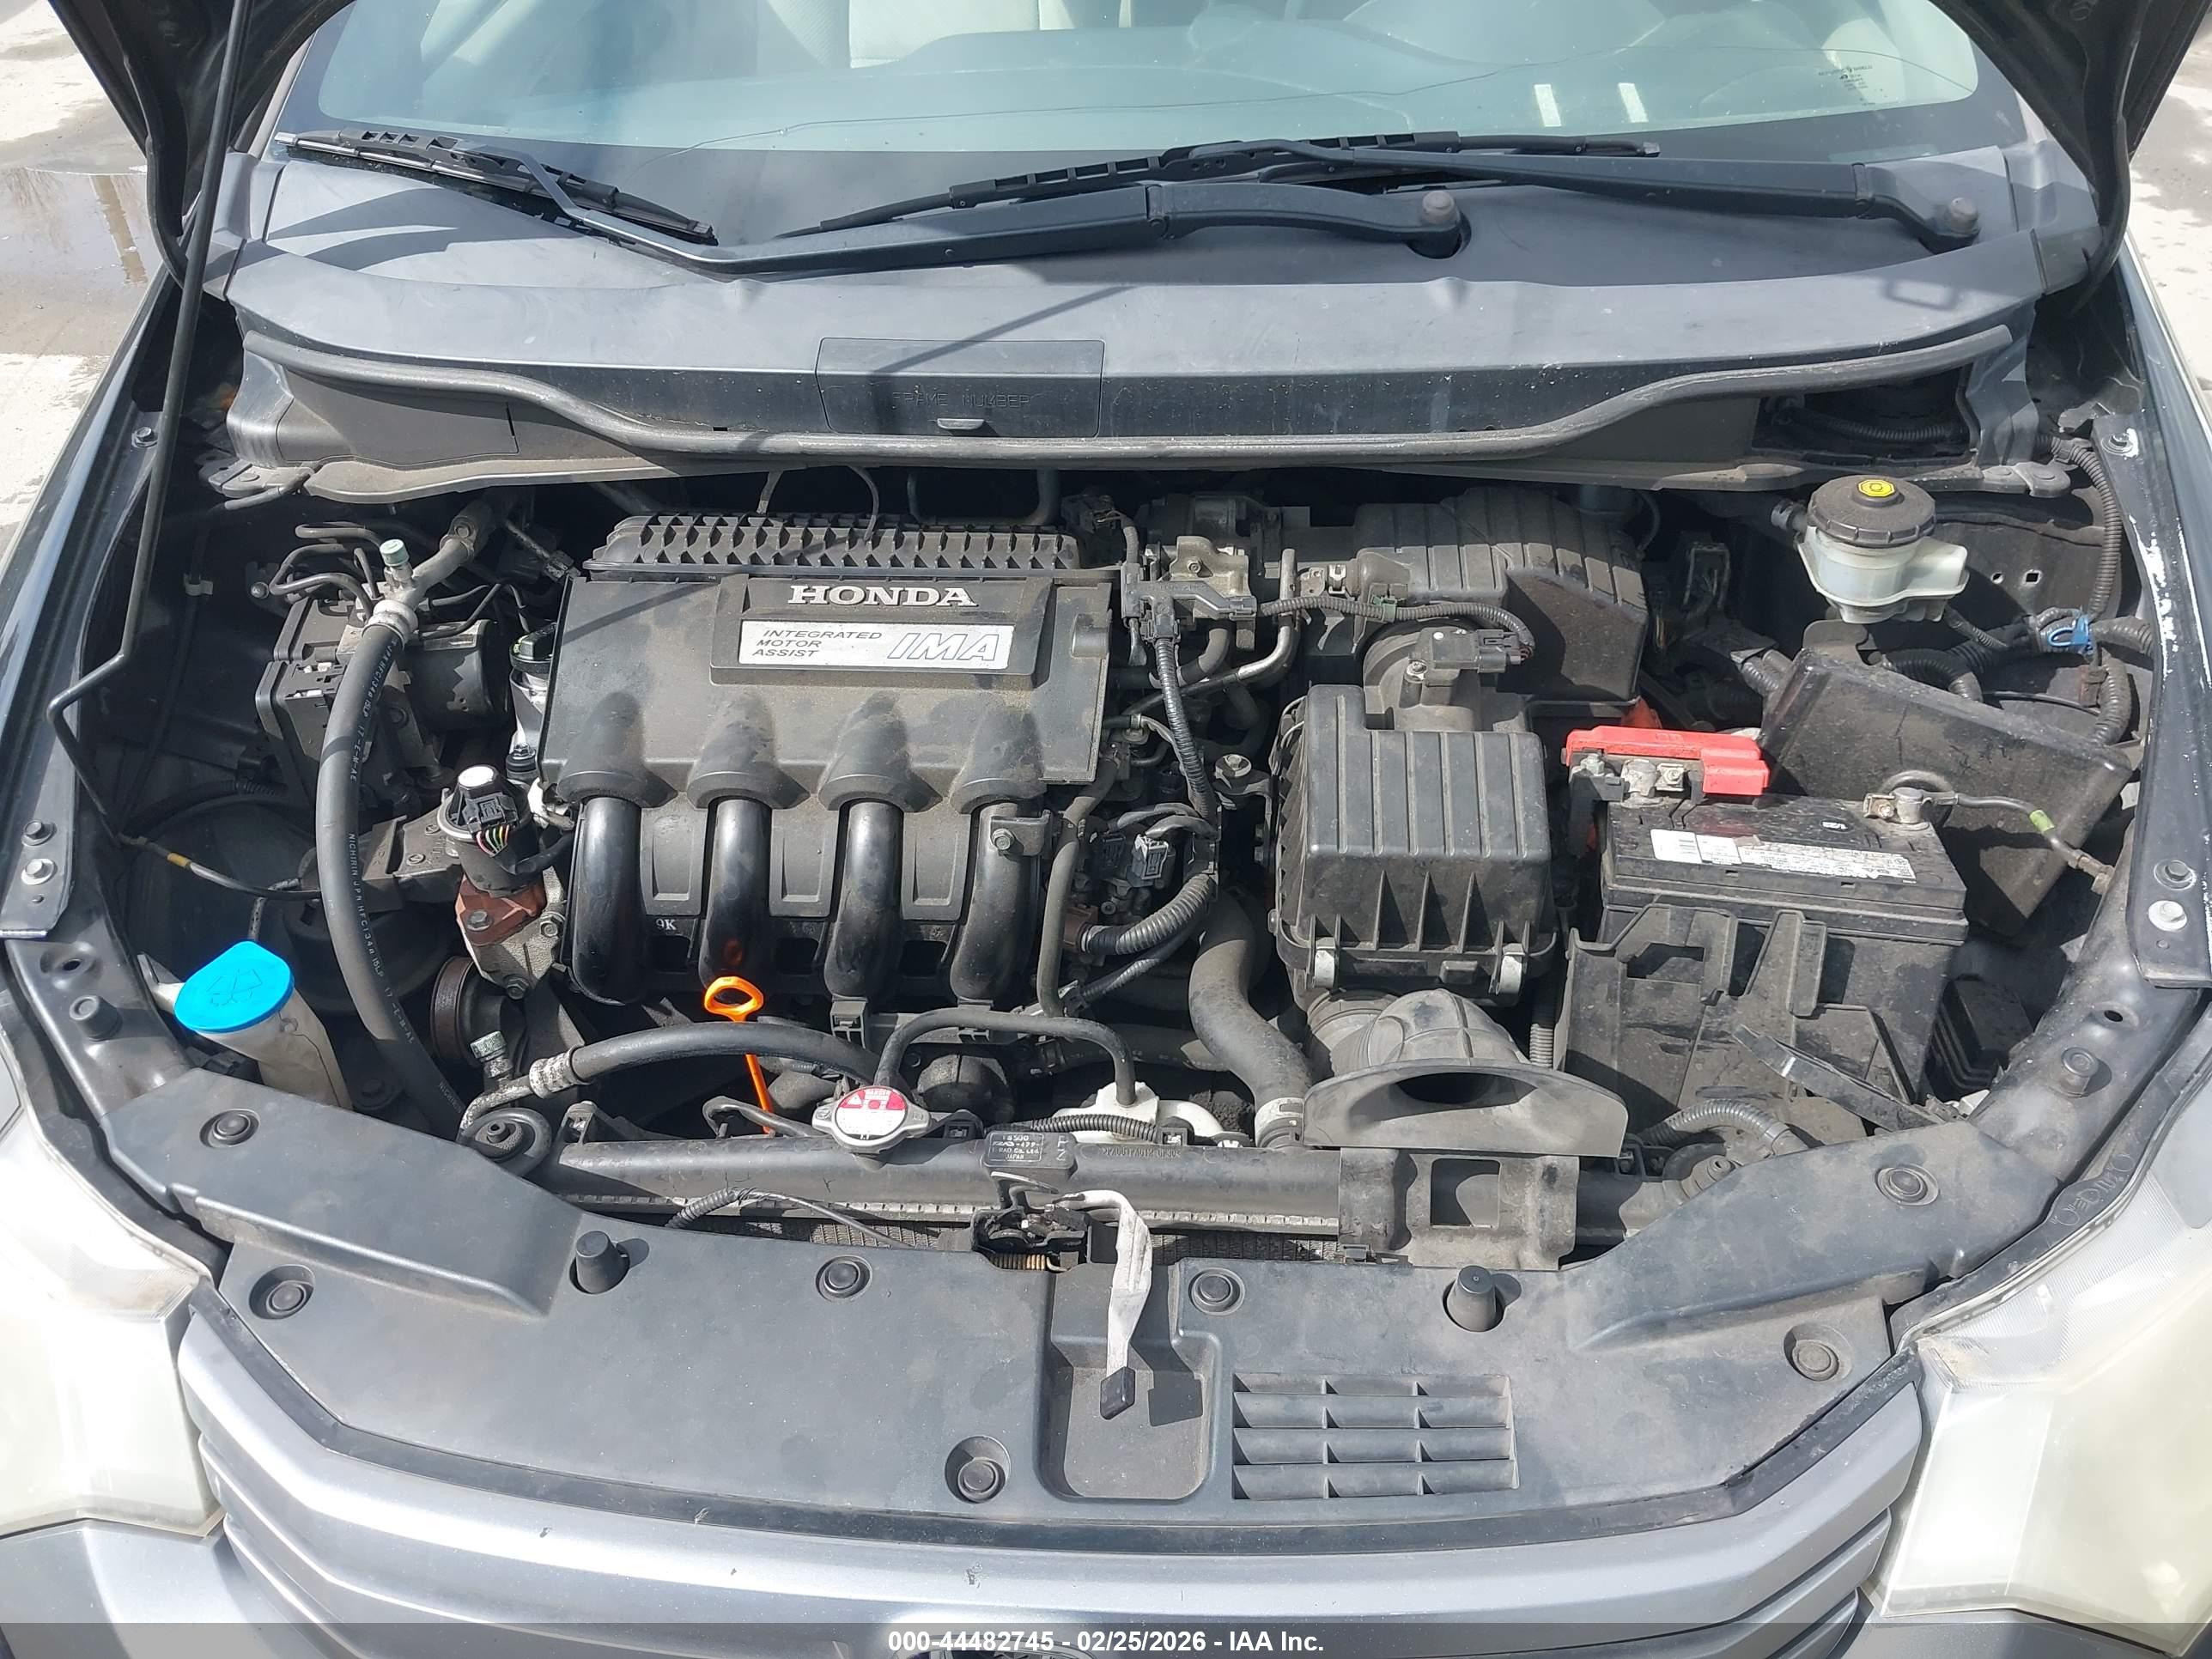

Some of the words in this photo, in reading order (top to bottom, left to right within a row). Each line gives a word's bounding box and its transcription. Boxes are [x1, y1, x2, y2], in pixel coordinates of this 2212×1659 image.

[787, 585, 980, 607] HONDA
[763, 629, 883, 640] INTEGRATED
[752, 649, 819, 658] ASSIST
[887, 633, 1000, 661] IMA
[349, 832, 358, 878] NICHIRIN
[655, 918, 678, 931] 9K
